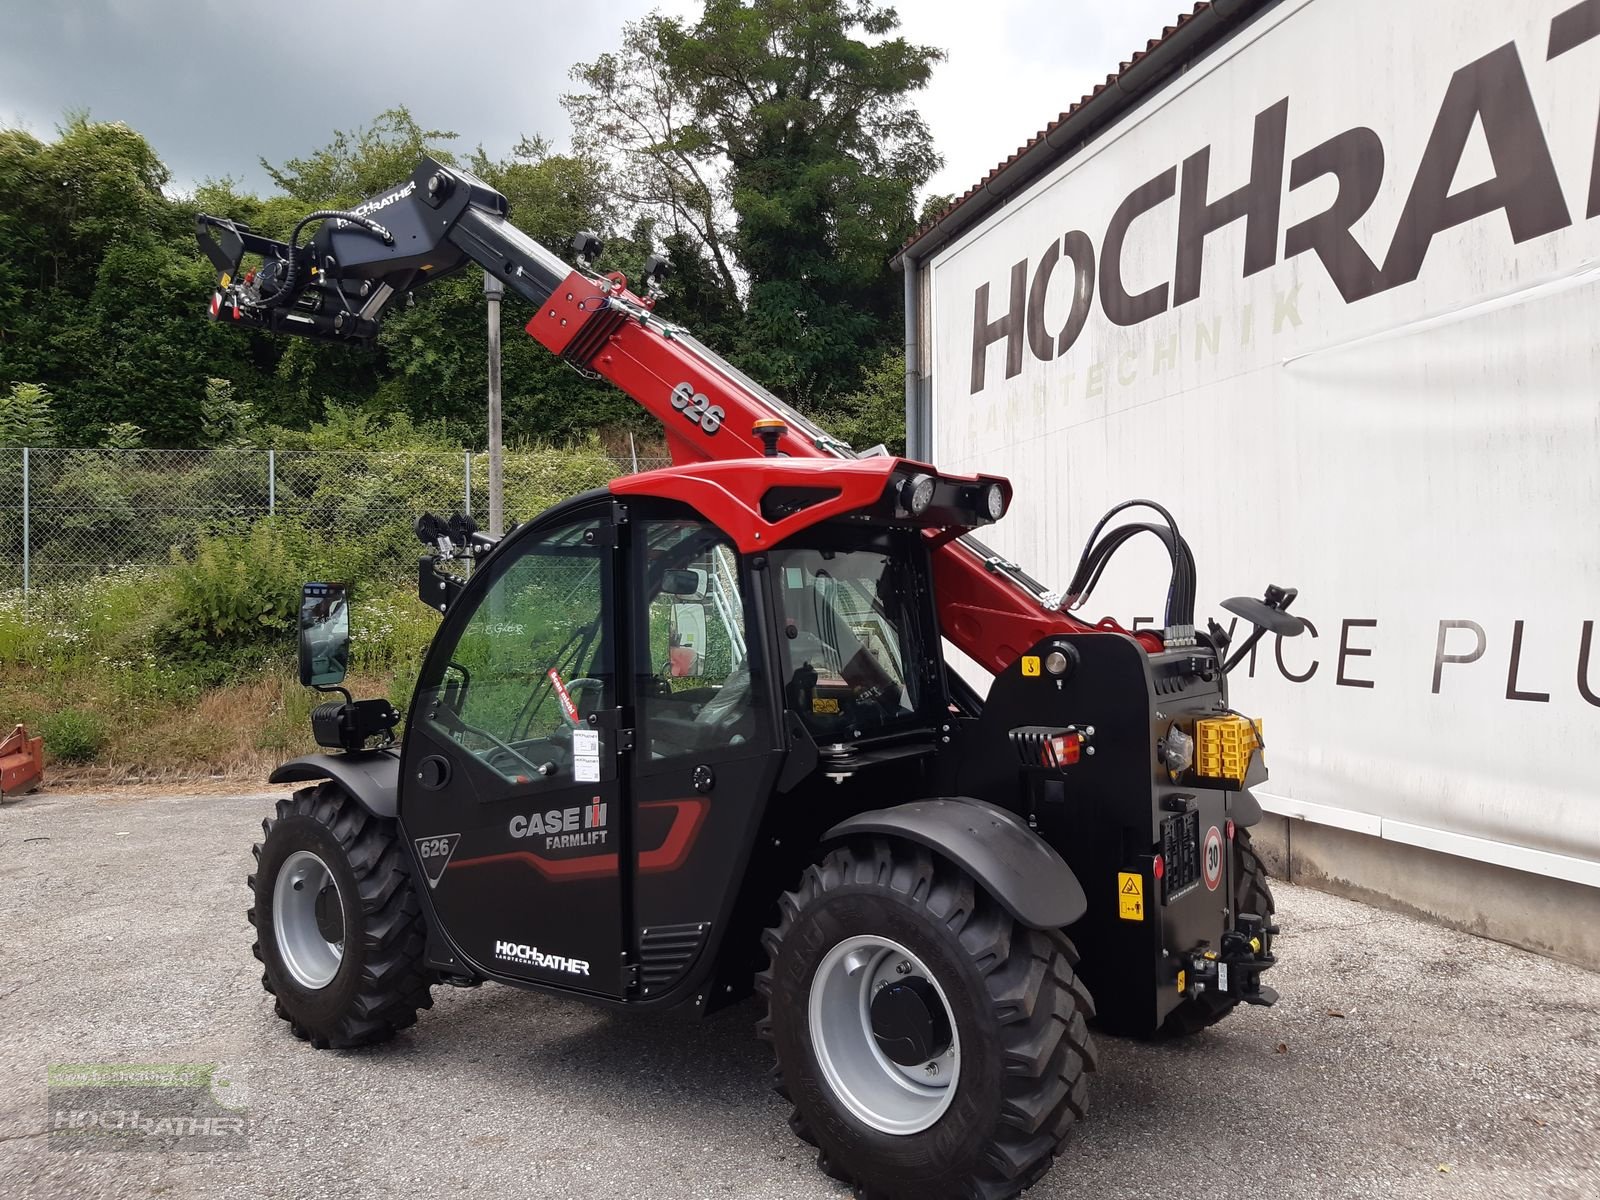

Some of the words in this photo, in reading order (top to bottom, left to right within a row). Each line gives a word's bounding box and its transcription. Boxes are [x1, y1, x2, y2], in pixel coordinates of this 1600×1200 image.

[671, 381, 726, 435] 626
[509, 807, 580, 838] CASE
[420, 839, 450, 858] 626
[546, 830, 608, 850] FARMLIFT
[1208, 844, 1219, 871] 30
[495, 940, 590, 976] HOCHRATHER
